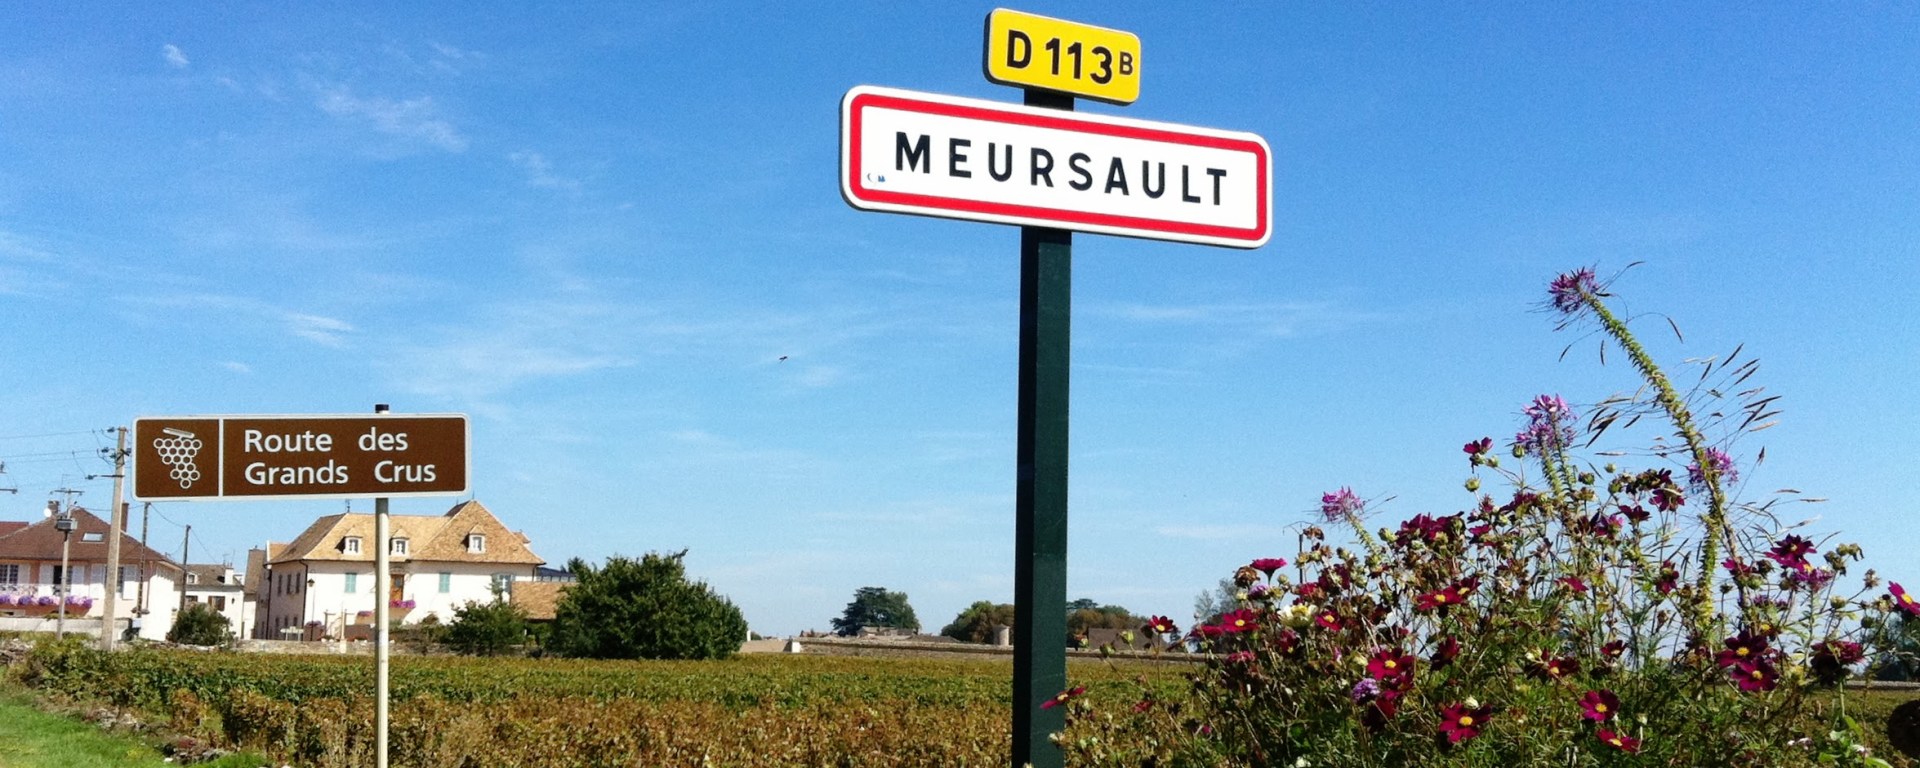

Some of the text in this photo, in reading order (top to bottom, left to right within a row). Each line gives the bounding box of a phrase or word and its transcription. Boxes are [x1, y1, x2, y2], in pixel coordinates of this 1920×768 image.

[1006, 29, 1032, 69] D
[895, 131, 1227, 205] MEURSAULT
[244, 427, 408, 453] Route des
[244, 459, 436, 485] Grands Crus
